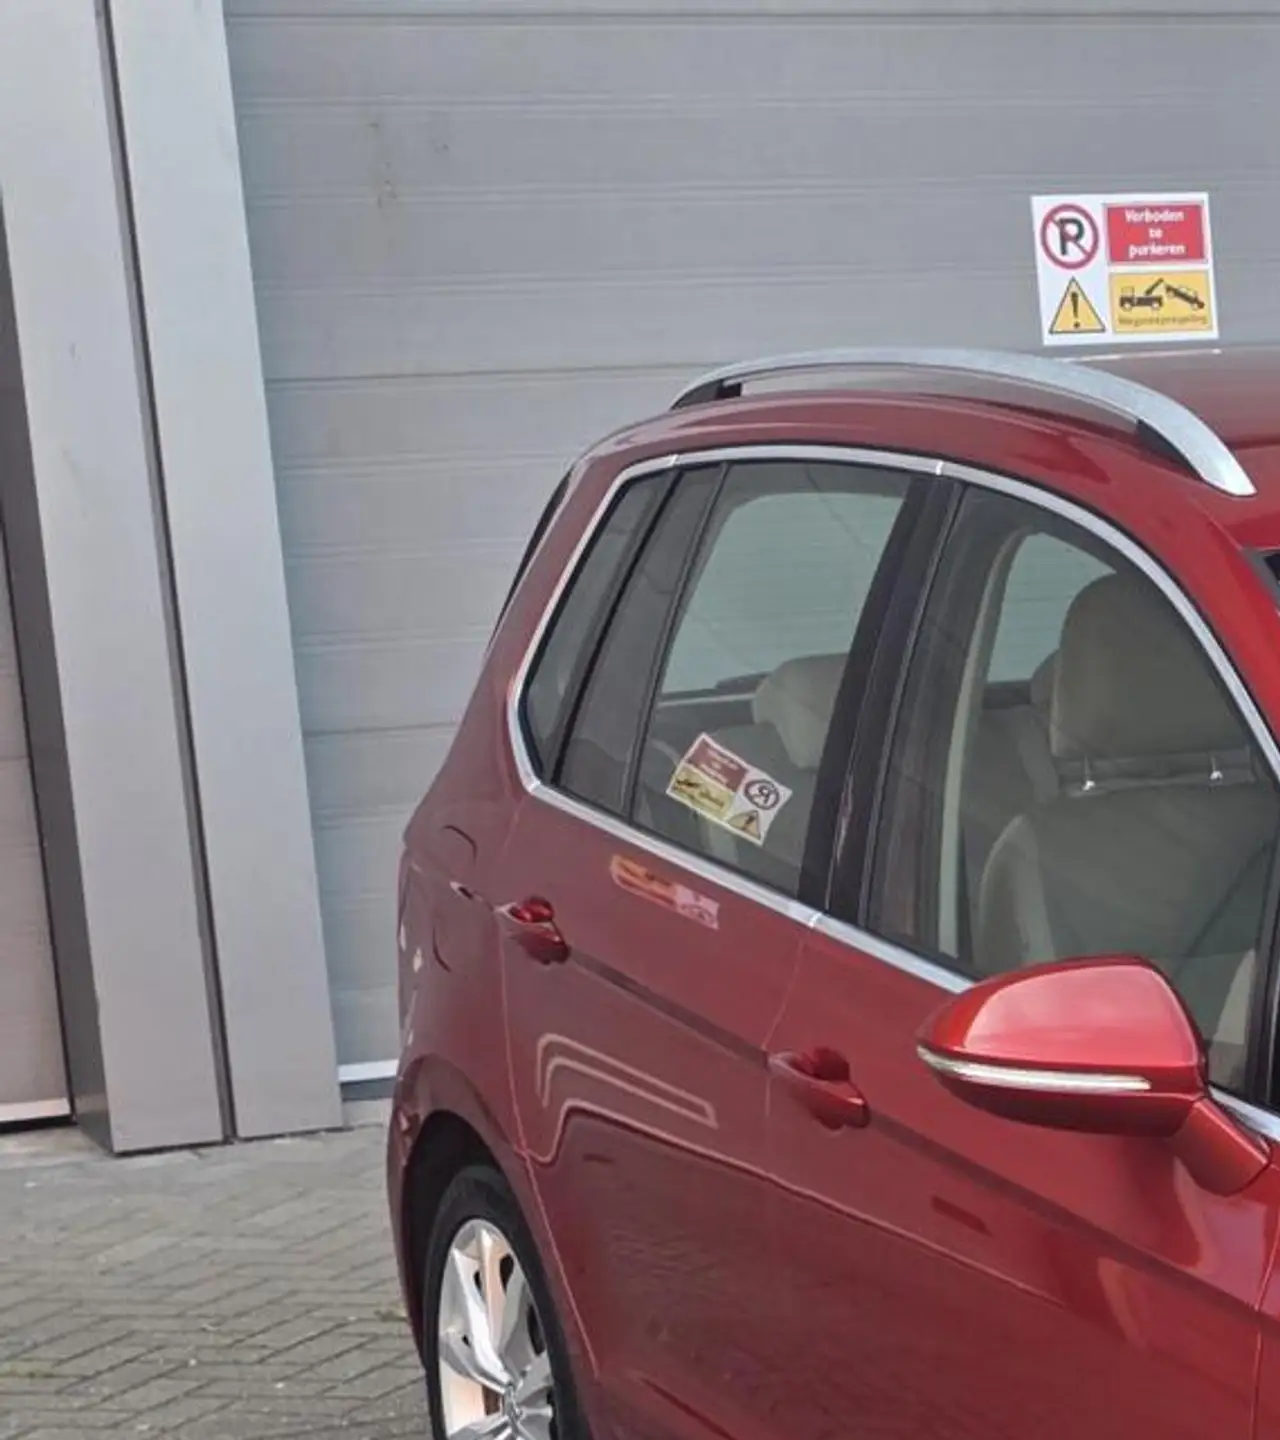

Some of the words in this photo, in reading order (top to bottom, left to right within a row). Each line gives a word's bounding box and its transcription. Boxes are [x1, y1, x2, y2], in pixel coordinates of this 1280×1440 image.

[1124, 208, 1184, 223] Verboden
[1148, 228, 1163, 239] te
[1129, 242, 1186, 259] parkeren
